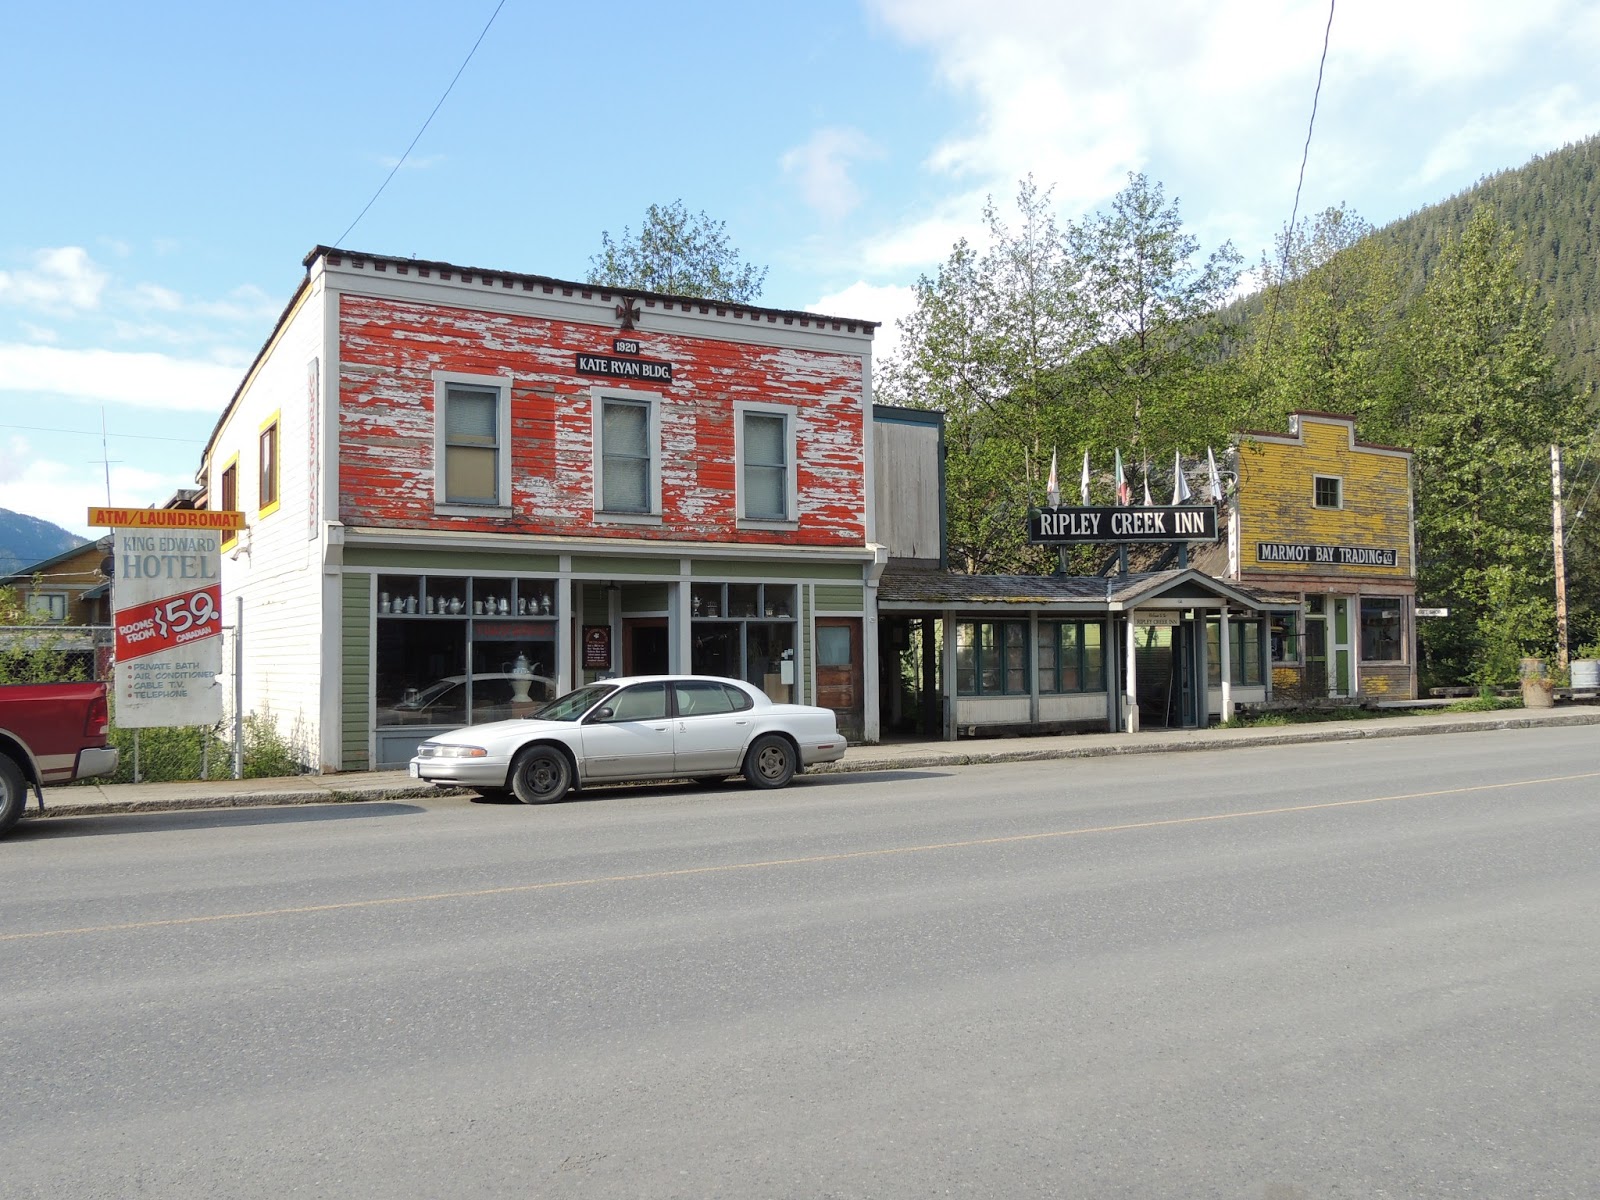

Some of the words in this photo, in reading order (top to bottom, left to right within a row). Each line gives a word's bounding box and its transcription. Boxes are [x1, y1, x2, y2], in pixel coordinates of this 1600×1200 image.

[616, 342, 637, 353] 1920
[580, 357, 608, 372] KATE
[610, 360, 640, 375] RYAN
[642, 364, 671, 379] BLDG.
[95, 510, 239, 527] ATM/LAUNDROMAT
[1040, 513, 1101, 535] RIPLEY
[1111, 512, 1166, 535] CREEK
[1174, 511, 1204, 533] INN
[123, 536, 155, 552] KING
[158, 537, 216, 552] EDWARD
[1261, 544, 1310, 561] MARMOT
[1316, 546, 1334, 562] BAY
[1338, 548, 1383, 564] TRADING
[122, 554, 216, 579] HOTEL
[119, 618, 154, 635] ROOMS
[176, 626, 212, 642] CANADIAN
[126, 628, 156, 644] FROM
[133, 663, 171, 671] PRIVATE
[175, 662, 200, 670] BATH
[134, 672, 151, 680] AIR
[155, 671, 215, 680] CONDITIONED
[133, 681, 163, 690] CABLE
[168, 681, 185, 689] T.V.
[134, 690, 187, 699] TELEPHONE
